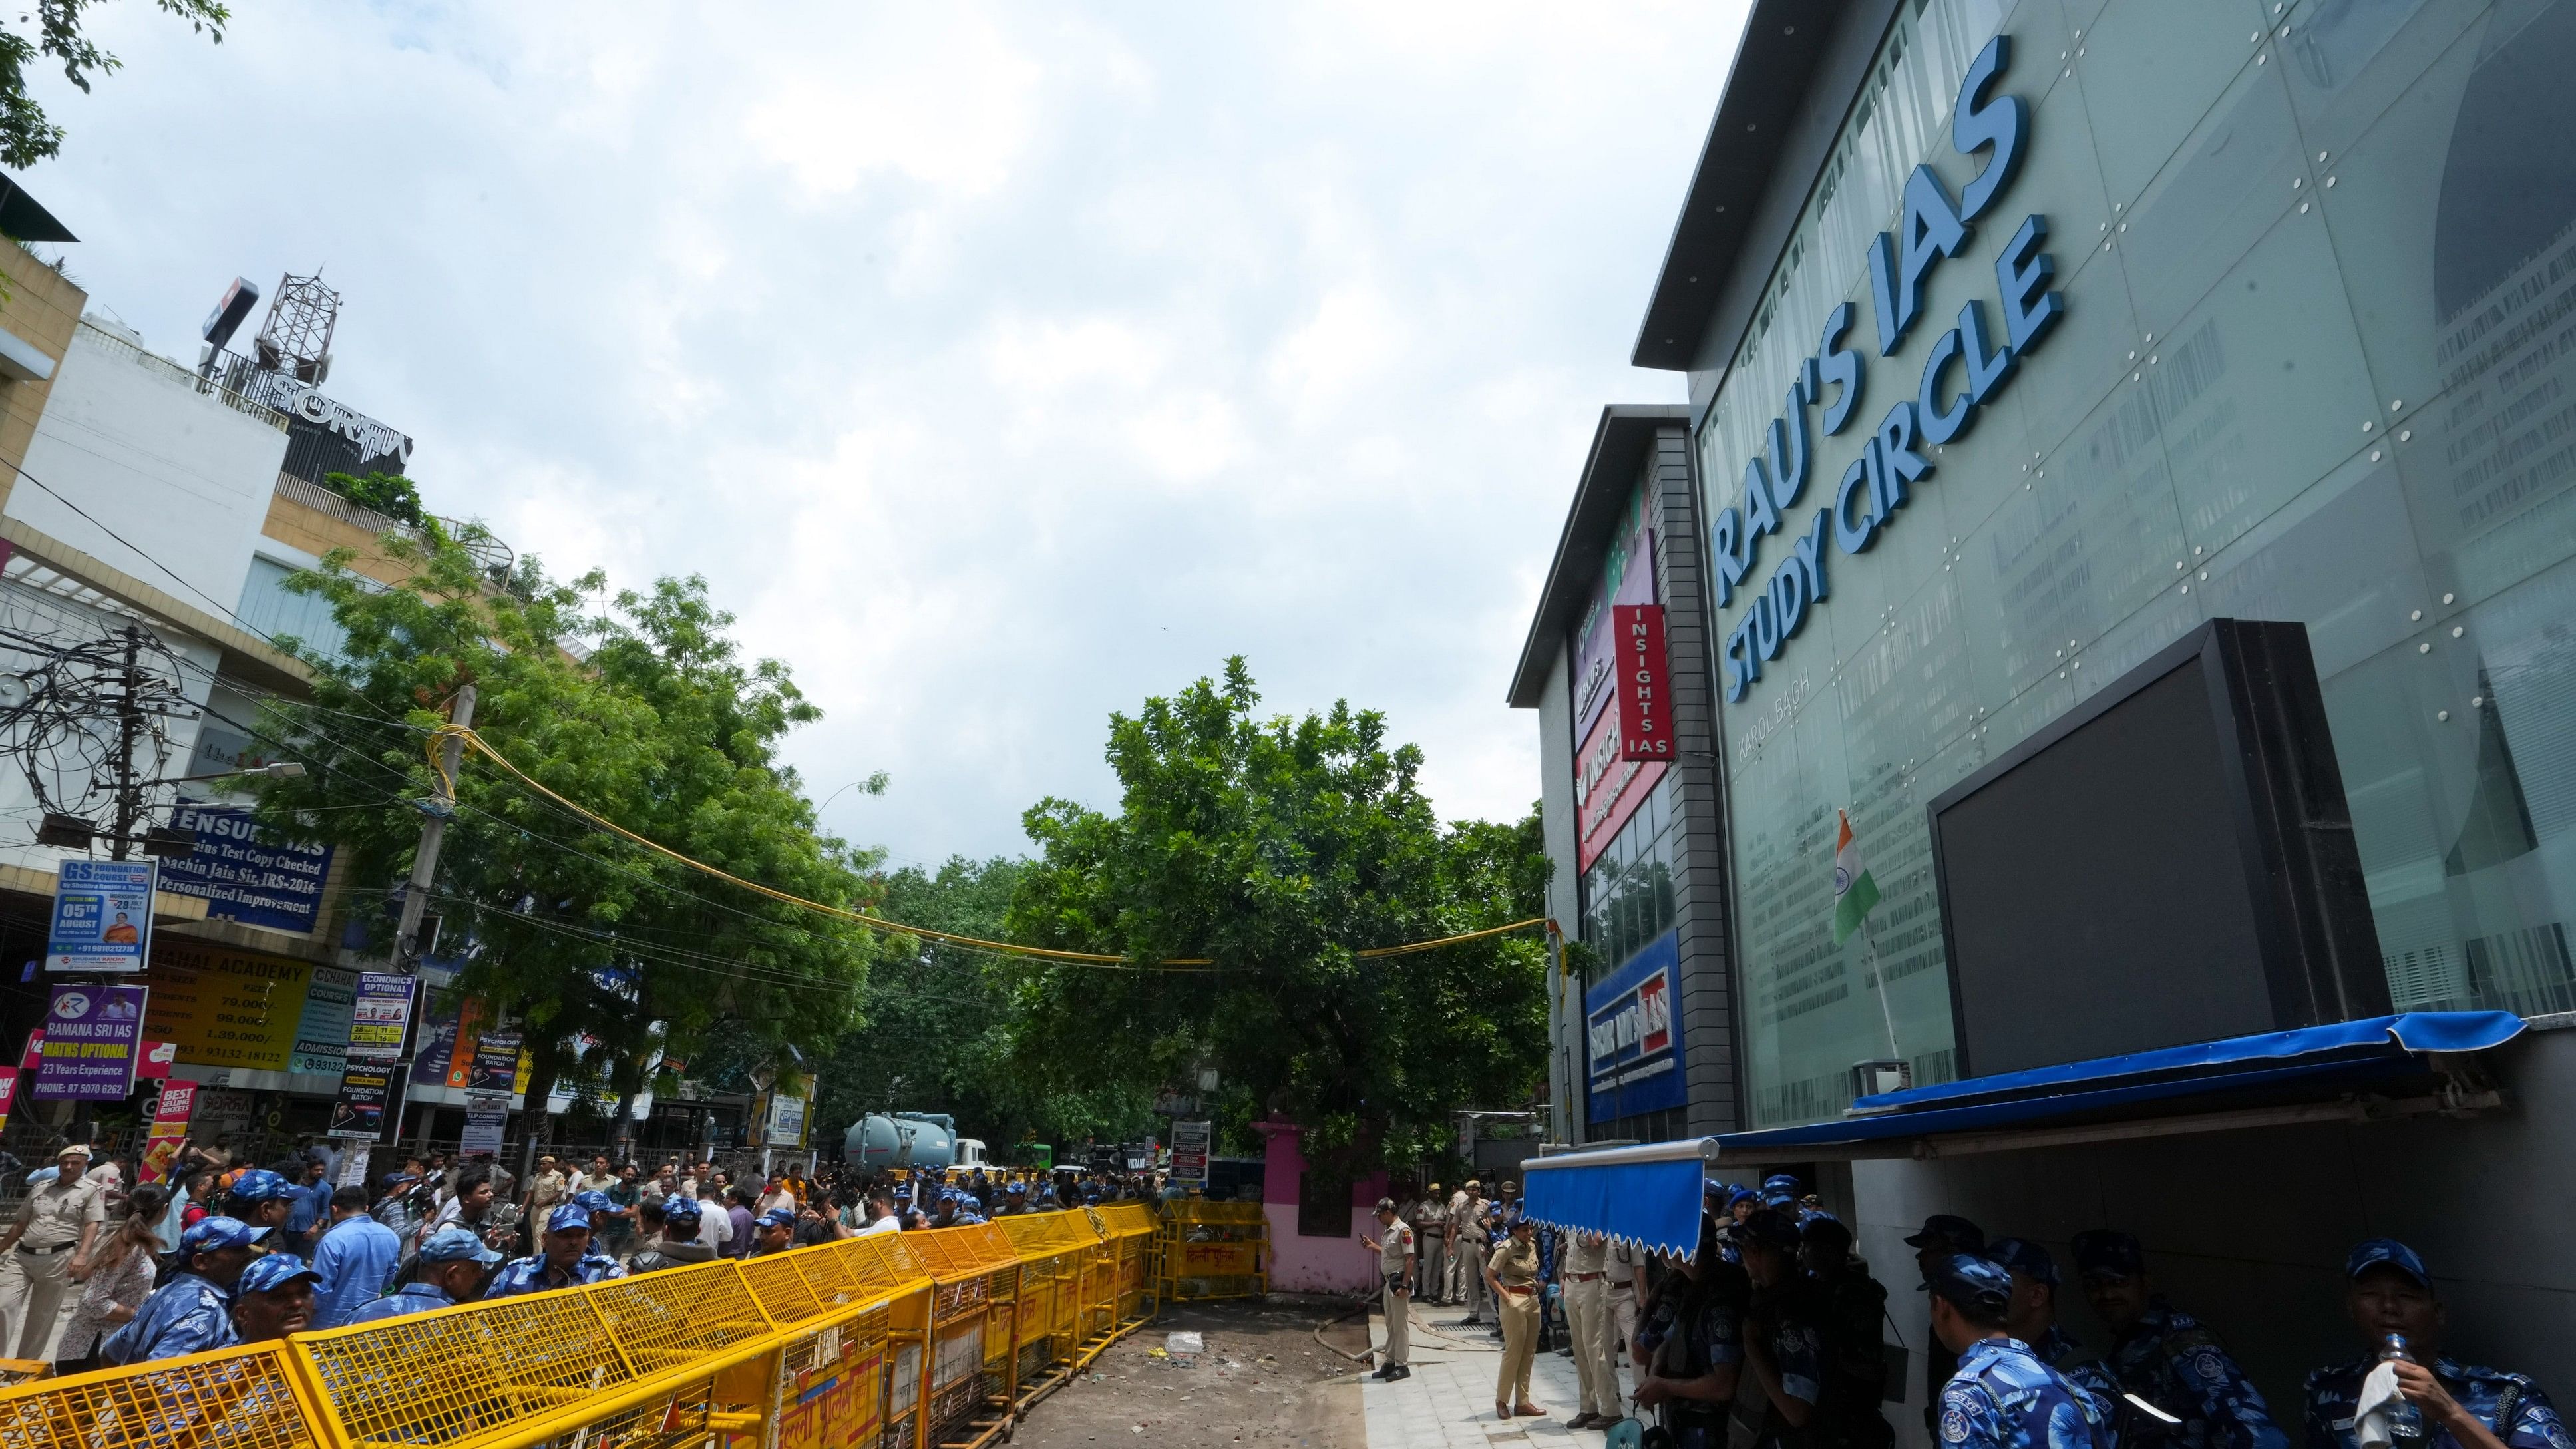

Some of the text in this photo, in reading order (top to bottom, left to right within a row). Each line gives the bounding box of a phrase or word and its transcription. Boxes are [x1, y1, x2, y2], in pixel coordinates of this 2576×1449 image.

[1712, 35, 2028, 609] RAU'S IAS
[1725, 214, 2063, 704] STUDY CIRCLE
[1632, 608, 1653, 732] INSIGHTS
[1738, 666, 1810, 762] KAROL BAGH
[1630, 739, 1667, 753] IAS
[193, 839, 321, 875] ains Test Copy Checked
[64, 862, 148, 880] GS FOUNDATION
[162, 856, 206, 875] Sachin
[208, 862, 235, 880] Jain
[158, 875, 311, 915] Personalized Improvement
[116, 900, 128, 910] 28
[218, 958, 303, 982] ACADEMY
[362, 975, 412, 985] ECONOMICS
[364, 984, 407, 992] OPTIONAL
[150, 992, 197, 1002] TUDENTS
[310, 988, 349, 1002] COURSES
[146, 1008, 192, 1020] TUDENTS
[47, 1022, 132, 1038] RAMANA SRI IAS
[479, 1036, 521, 1046] PSYCHOLOGY
[43, 1042, 79, 1058] MATHS
[80, 1043, 128, 1058] OPTIONAL
[477, 1054, 516, 1062] FOUNDATION
[42, 1064, 123, 1077] 23 Years Experience
[346, 1065, 391, 1074] PSYCHOLOGY
[35, 1083, 122, 1094] PHONE: 87 5070 6262
[164, 1088, 194, 1100] BEST
[343, 1086, 385, 1096] FOUNDATION
[162, 1098, 190, 1108] SELLING
[160, 1106, 190, 1115] BUCKETS
[780, 1111, 791, 1121] QEP
[1127, 1158, 1146, 1169] VIKRANT
[1186, 1247, 1210, 1263] दिल्ली
